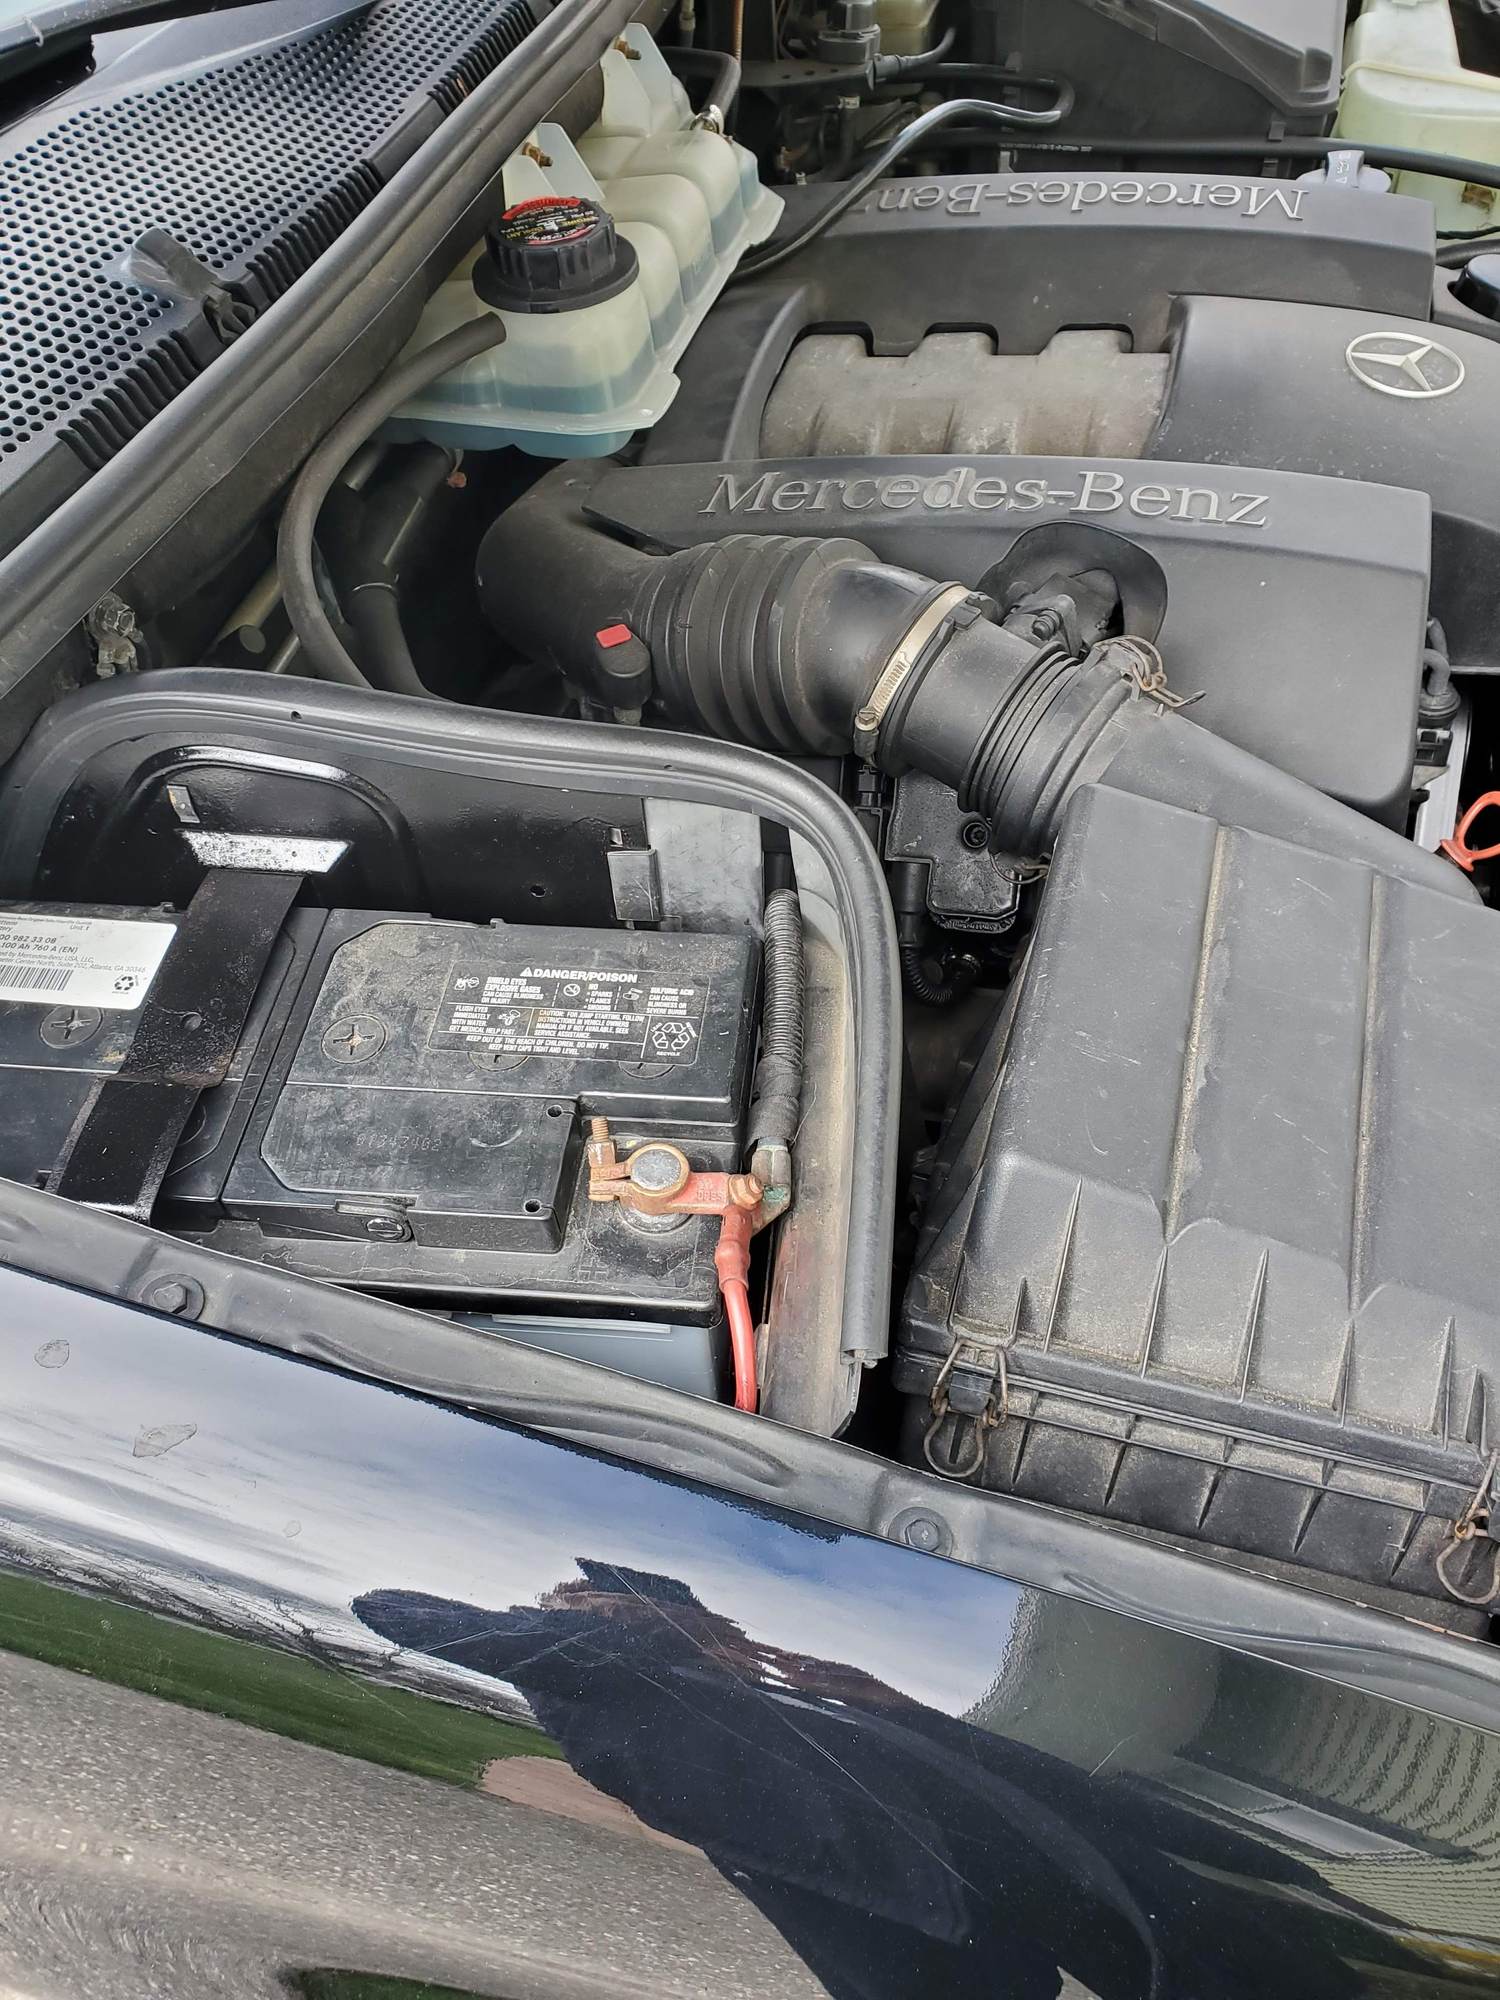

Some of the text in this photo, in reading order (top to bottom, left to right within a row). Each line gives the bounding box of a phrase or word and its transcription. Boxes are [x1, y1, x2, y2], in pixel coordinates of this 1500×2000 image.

[699, 466, 1270, 527] Mercedes-Benz
[58, 946, 78, 954] (EN)
[510, 978, 528, 986] EYES
[533, 968, 638, 984] DANGER/POISON
